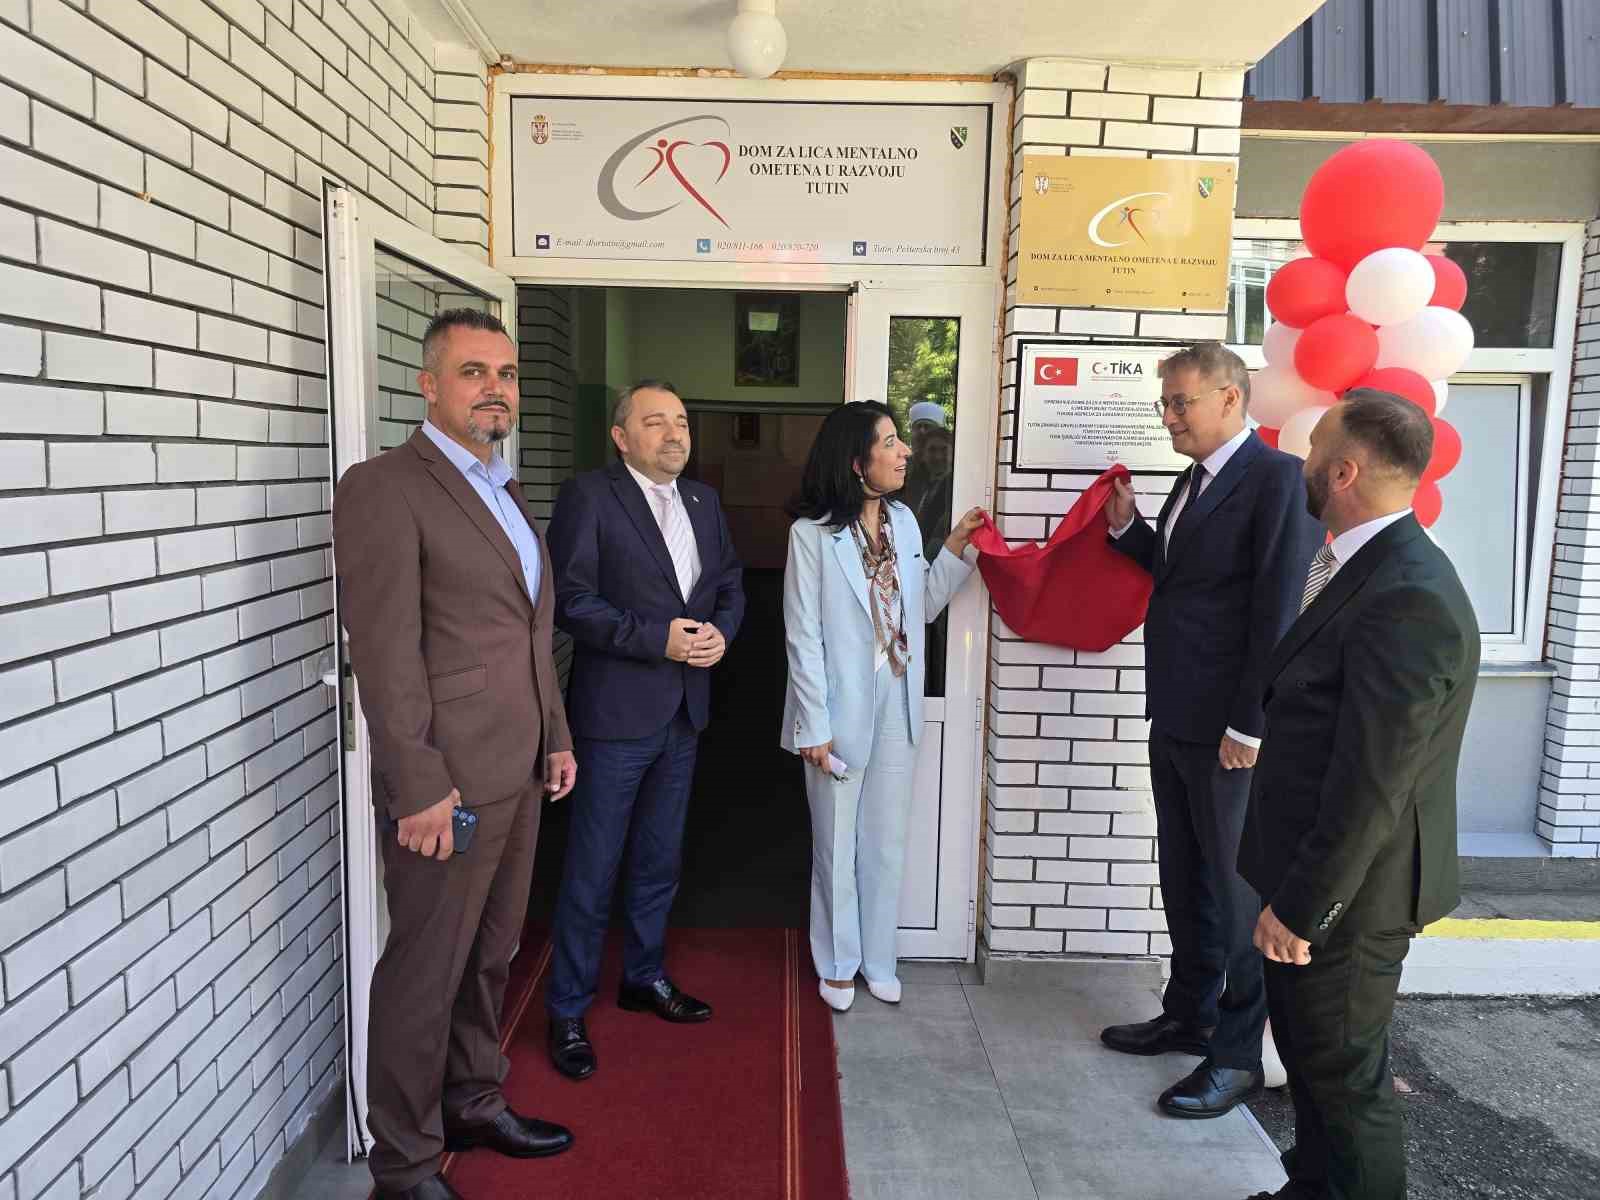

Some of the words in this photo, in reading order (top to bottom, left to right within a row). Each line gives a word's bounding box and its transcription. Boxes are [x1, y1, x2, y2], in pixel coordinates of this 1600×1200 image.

[738, 144, 772, 157] DOM
[775, 145, 795, 158] ZA
[799, 146, 833, 159] LICA
[837, 146, 918, 160] MENTALNO
[749, 163, 822, 176] OMETENA
[825, 164, 835, 177] U
[838, 164, 905, 178] RAZVOJU
[806, 181, 849, 195] TUTIN
[556, 239, 584, 249] E-mail:
[1031, 252, 1050, 260] DOM
[1083, 254, 1130, 263] MENTALNO
[1180, 257, 1218, 266] RAZVOJU
[1112, 266, 1136, 274] TUTIN
[1109, 359, 1143, 375] TİKA
